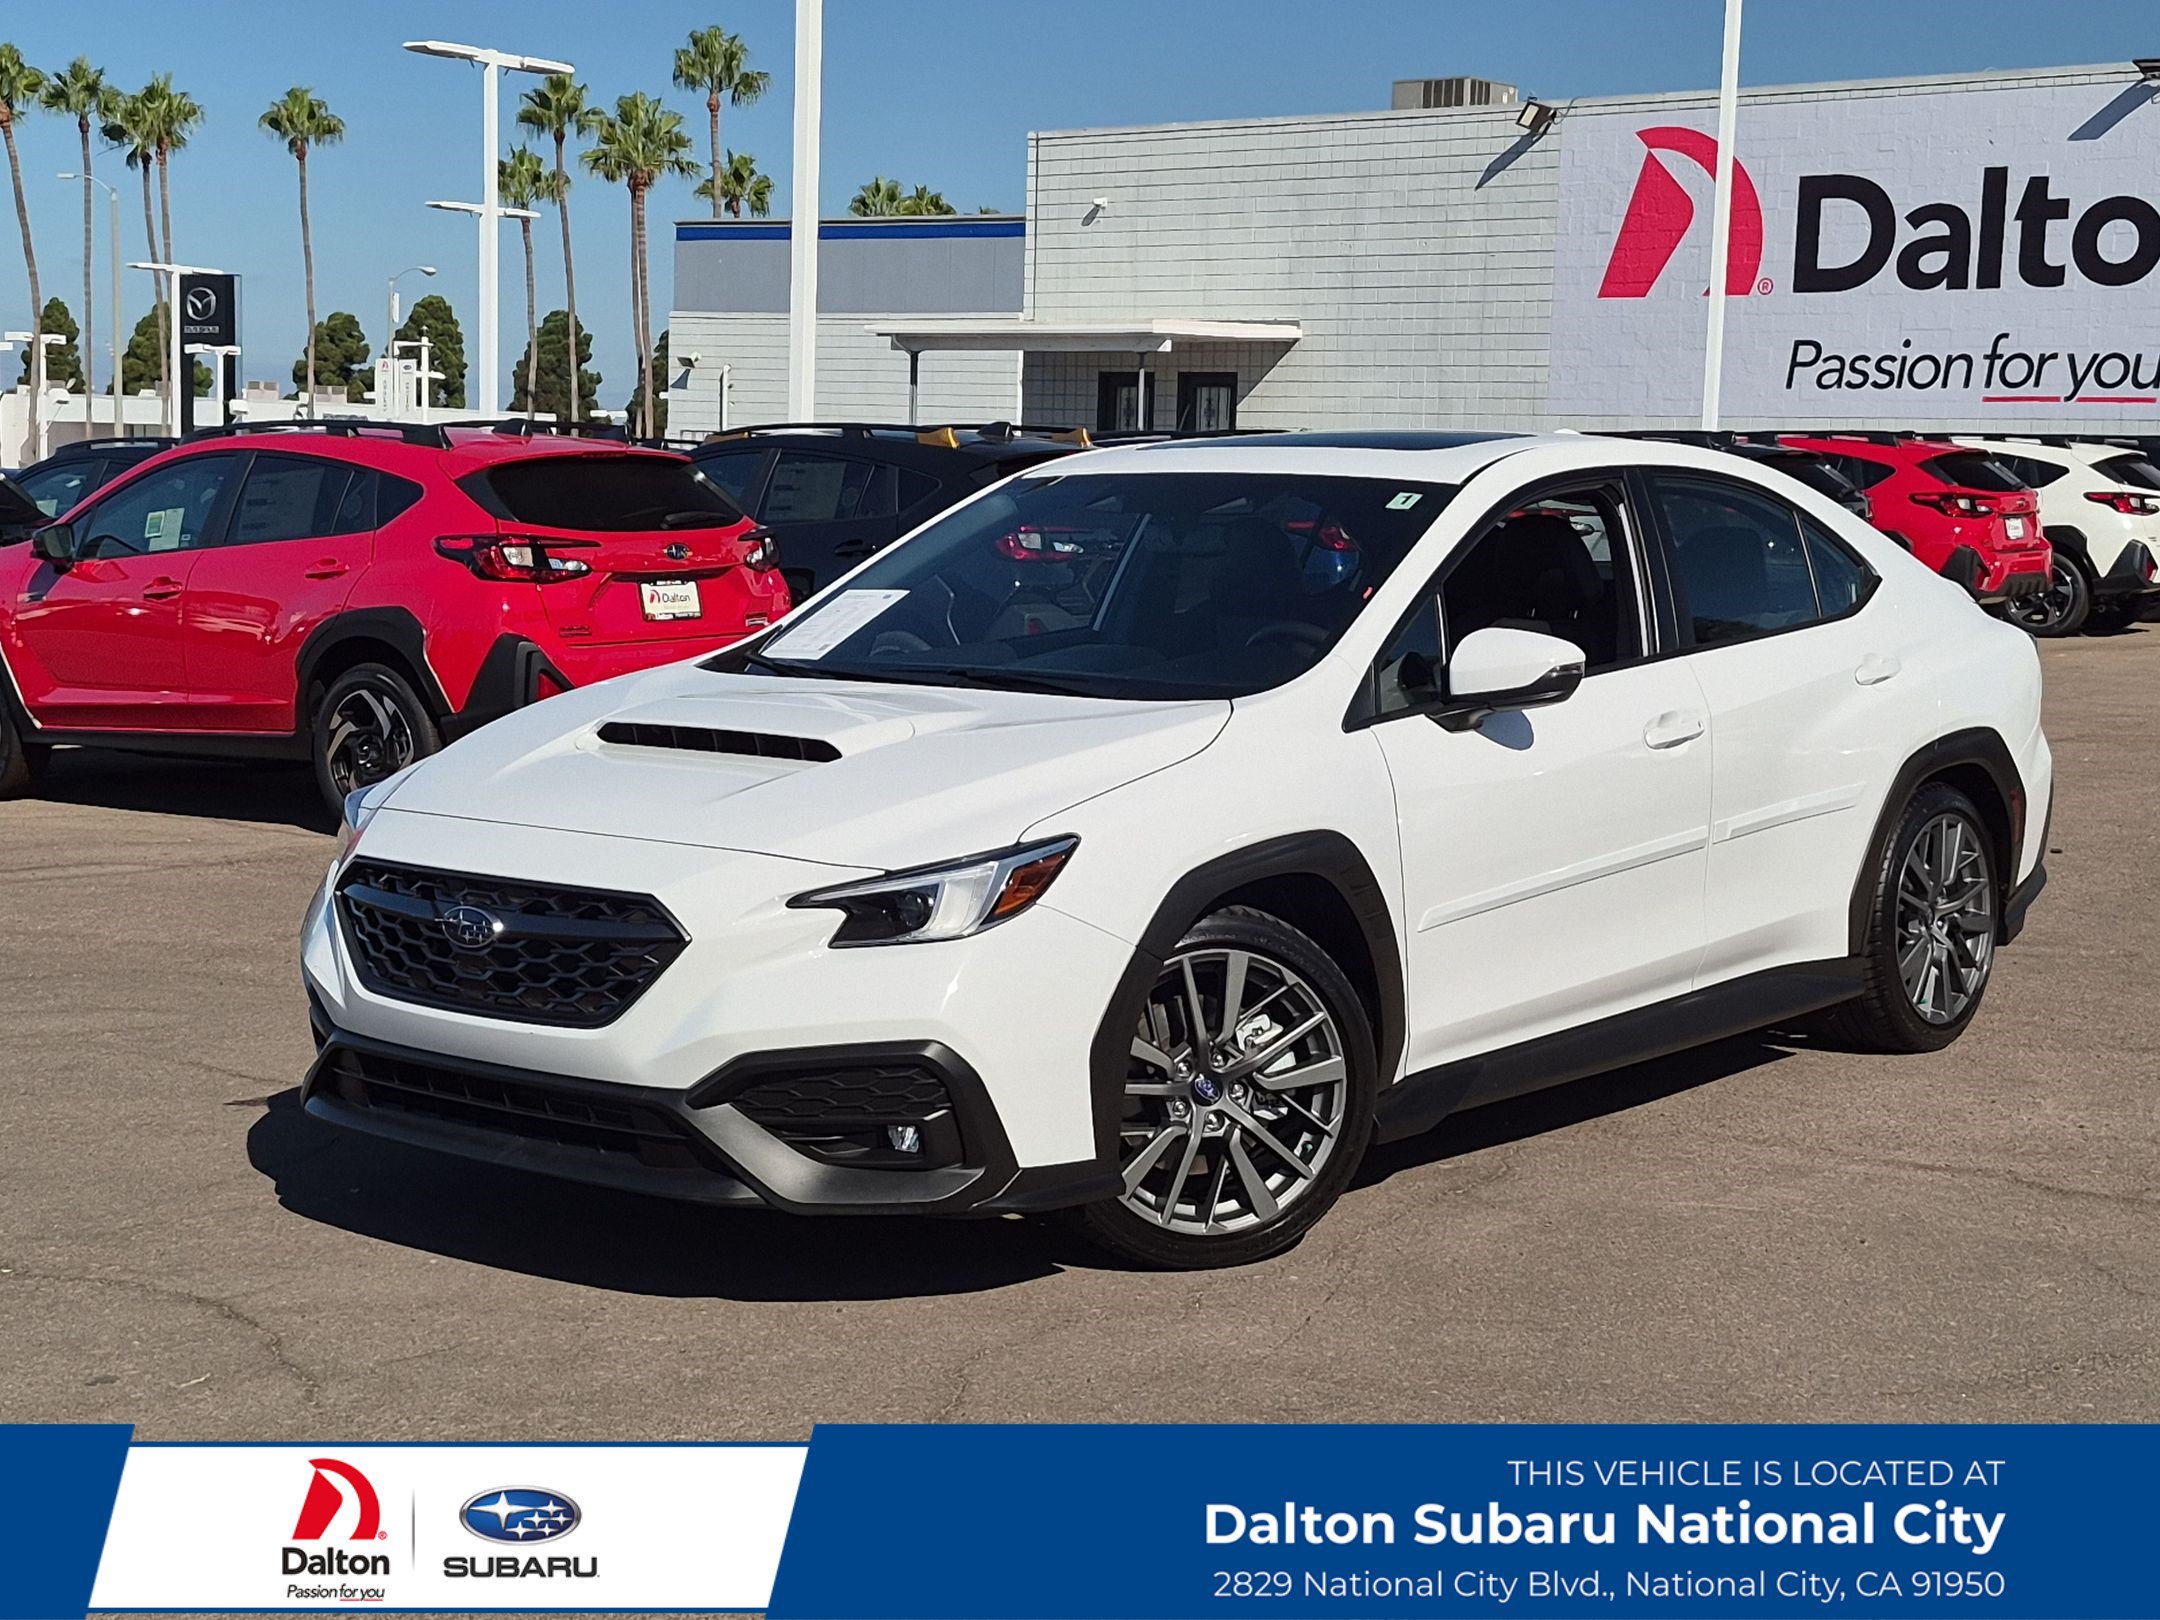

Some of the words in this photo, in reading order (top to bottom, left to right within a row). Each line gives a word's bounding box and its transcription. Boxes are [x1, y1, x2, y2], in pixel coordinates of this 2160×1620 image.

[1793, 166, 2160, 293] Dalto
[1786, 338, 1973, 390] Passion
[1983, 333, 2059, 389] for
[2064, 352, 2160, 402] you
